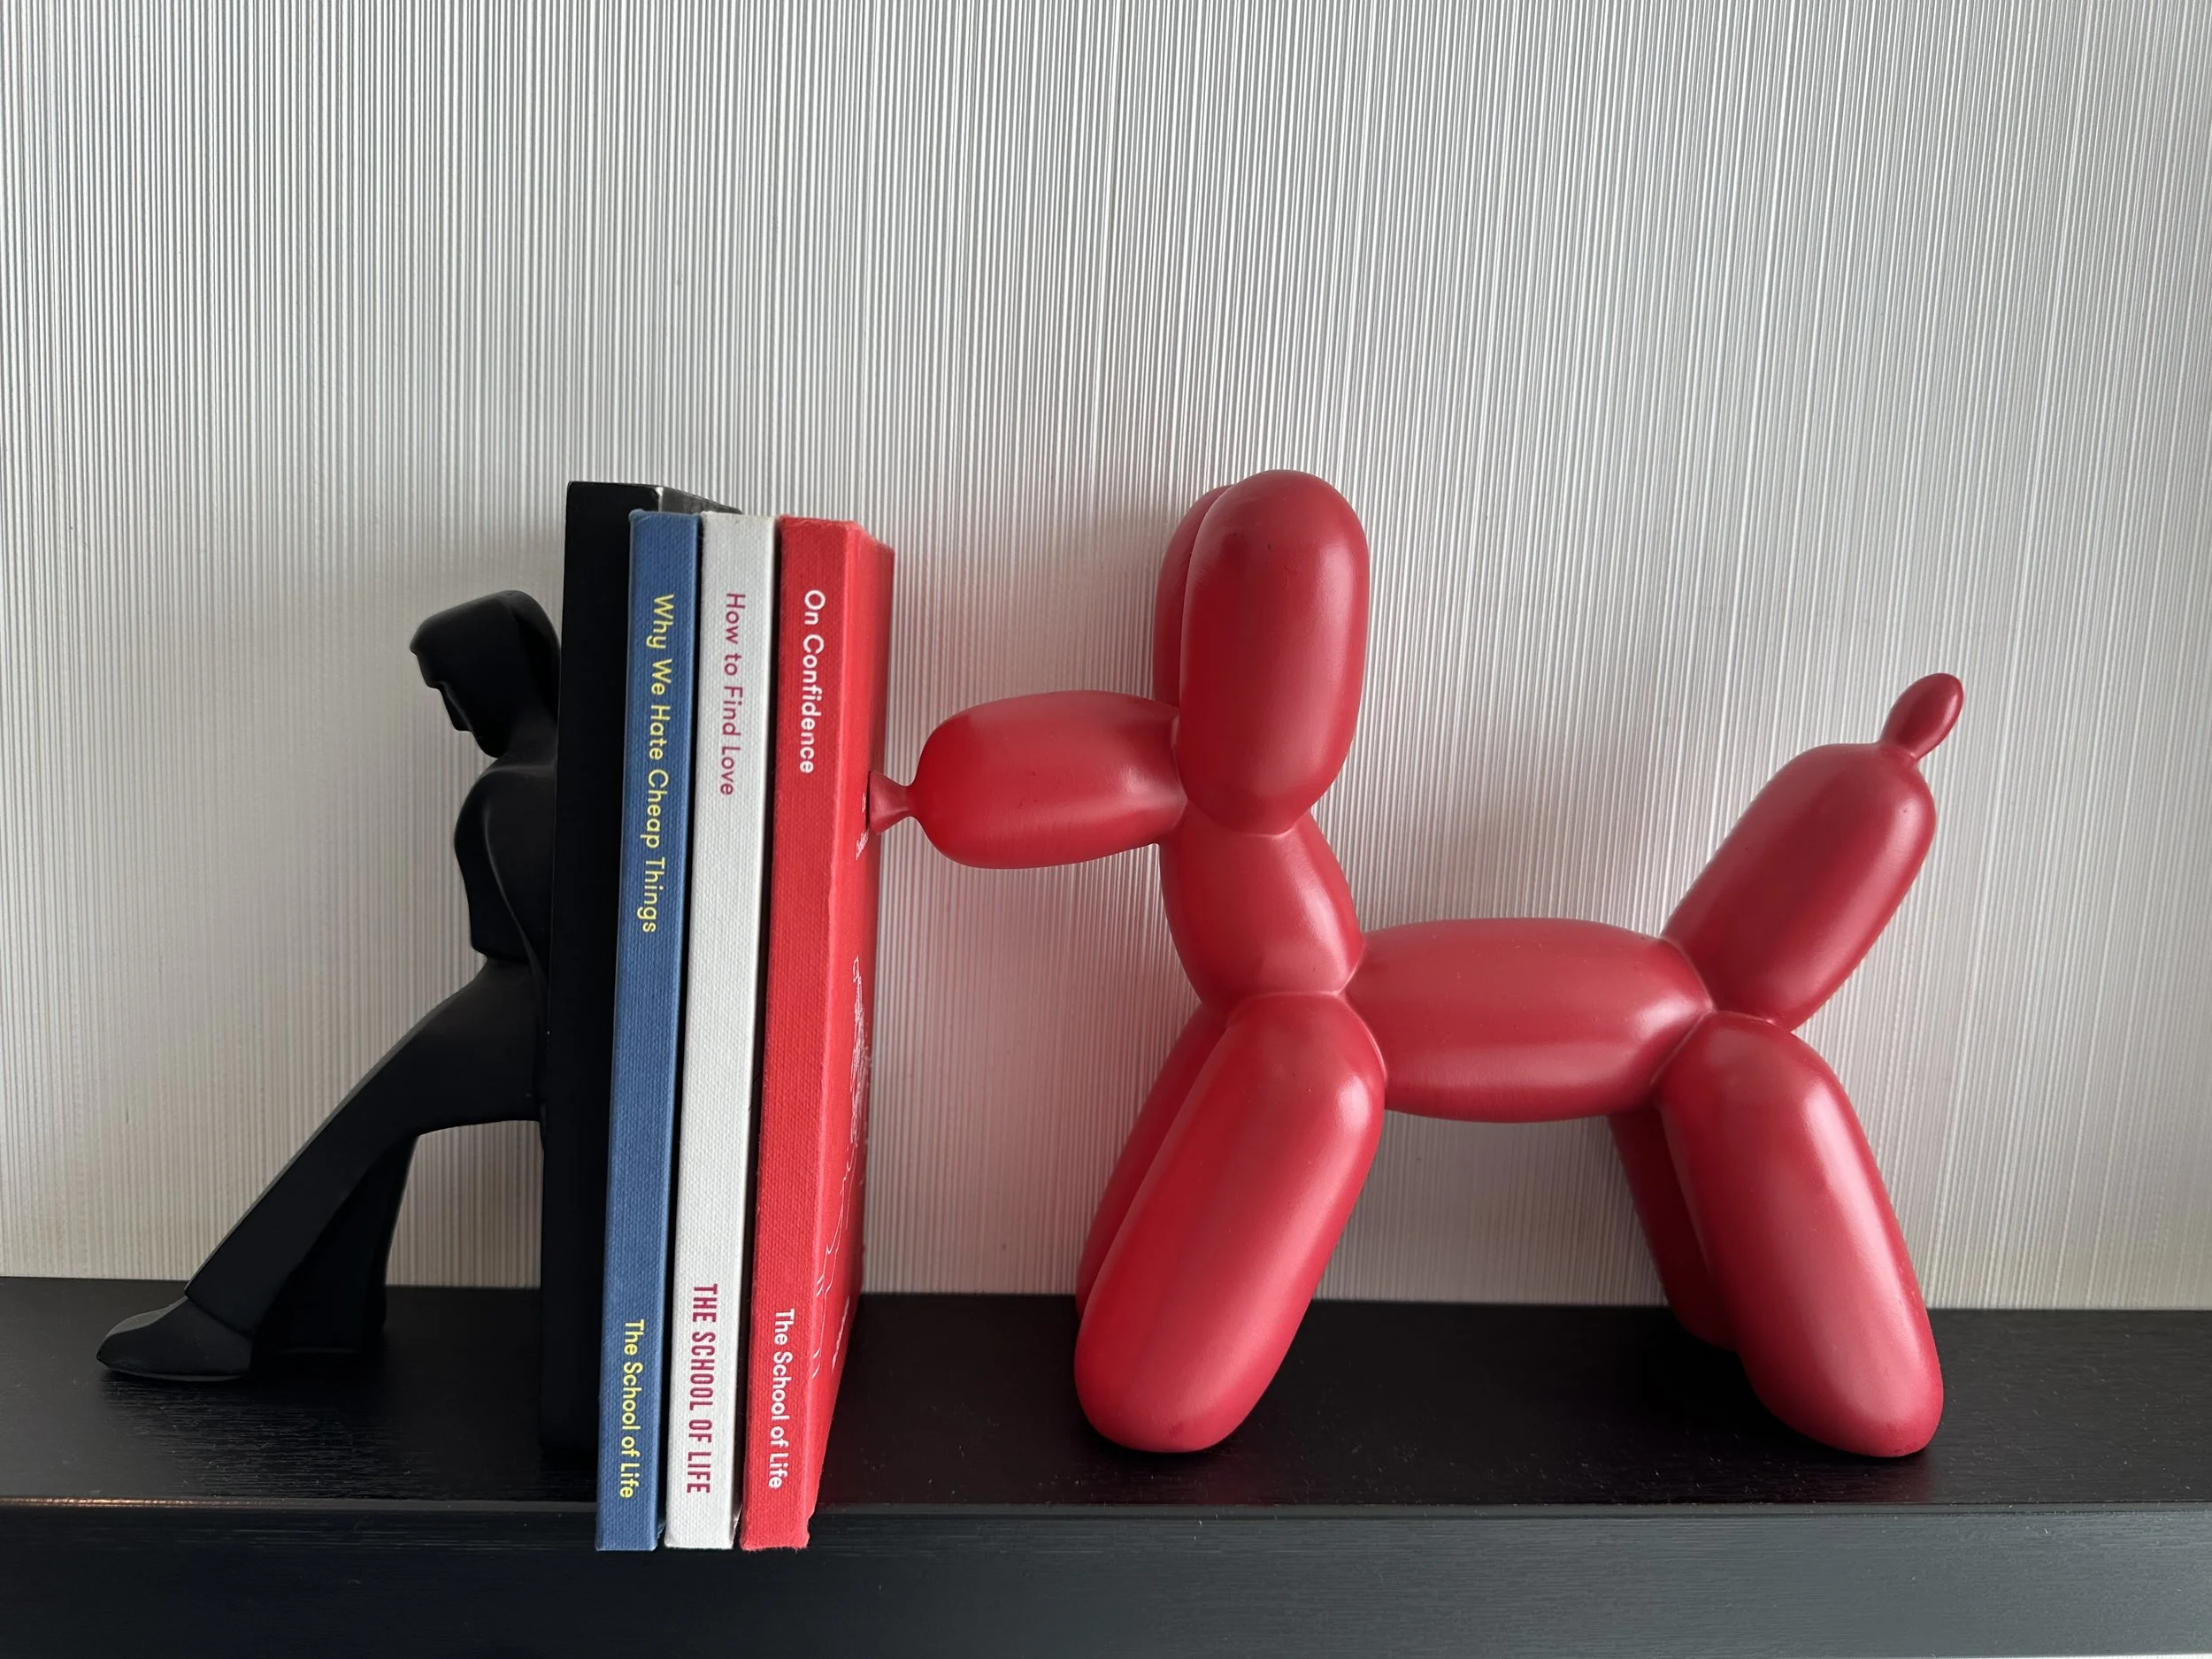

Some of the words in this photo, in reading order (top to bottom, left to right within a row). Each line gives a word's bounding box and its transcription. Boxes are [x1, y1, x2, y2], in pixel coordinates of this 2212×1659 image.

[647, 595, 673, 649] Why
[725, 594, 745, 644] How
[805, 590, 826, 625] On
[651, 659, 672, 695] We
[725, 655, 741, 676] to
[722, 687, 743, 735] Find
[800, 634, 824, 772] Confidence
[649, 705, 669, 759] Hate
[720, 747, 741, 795] Love
[641, 769, 669, 849] Cheap
[637, 859, 665, 932] Things
[693, 1285, 718, 1322] THE
[625, 1320, 644, 1356] The
[774, 1309, 795, 1345] The
[689, 1333, 716, 1409] SCHOOL
[772, 1352, 793, 1420] School
[622, 1363, 643, 1430] School
[621, 1436, 640, 1456] of
[689, 1419, 712, 1442] OF
[771, 1426, 788, 1448] of
[620, 1463, 639, 1498] Life
[687, 1452, 710, 1492] LIFE
[769, 1453, 788, 1488] Life
